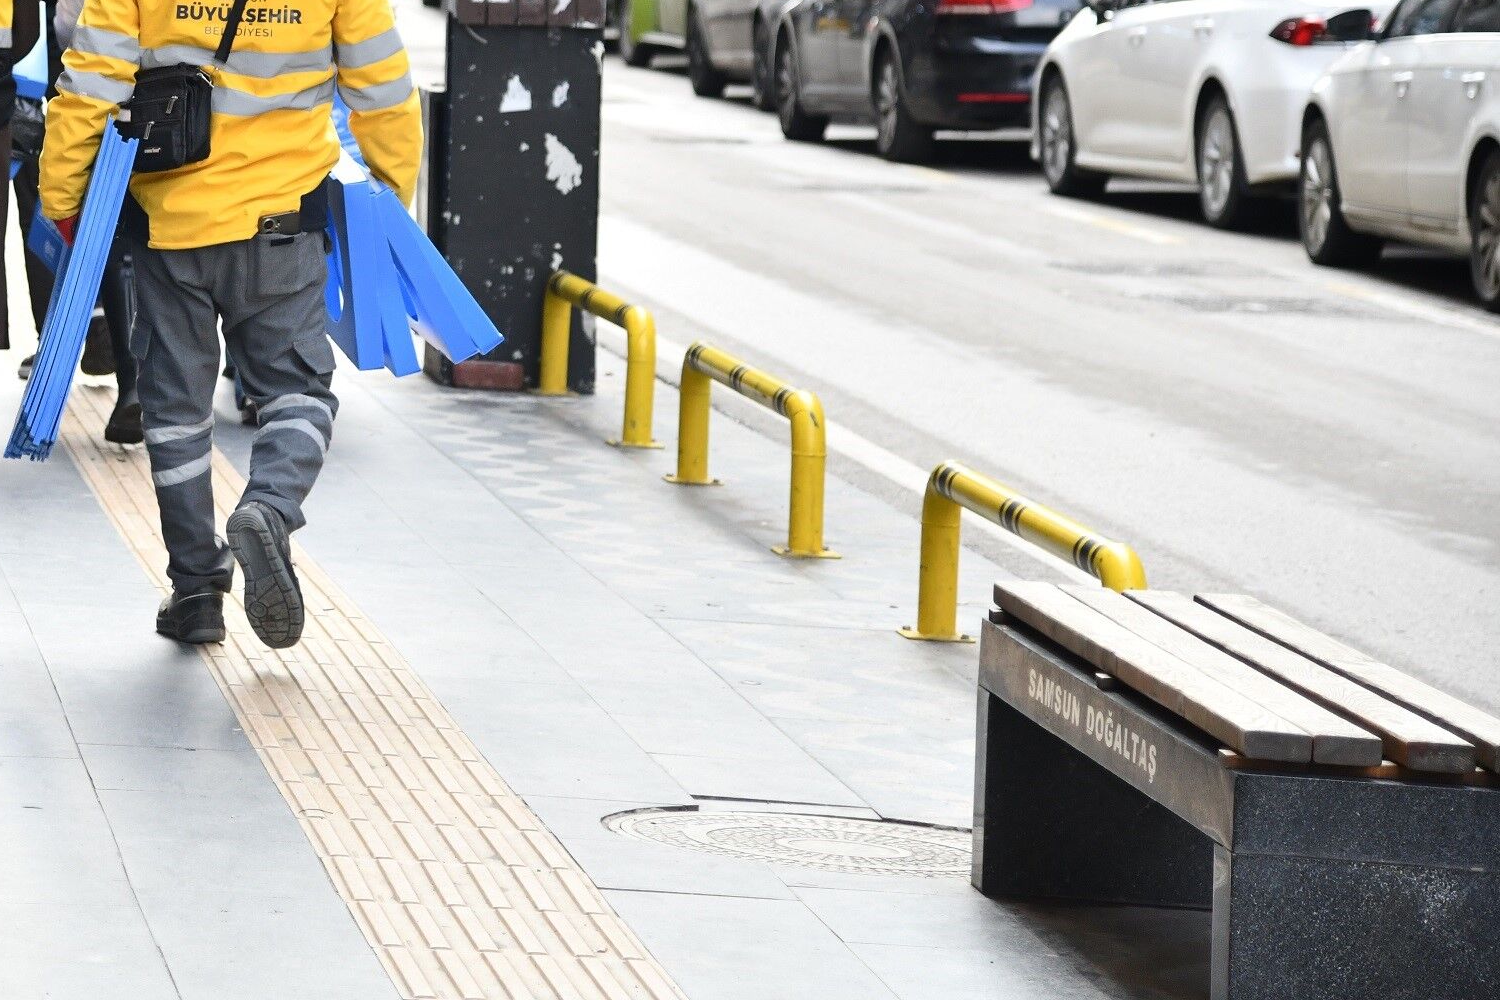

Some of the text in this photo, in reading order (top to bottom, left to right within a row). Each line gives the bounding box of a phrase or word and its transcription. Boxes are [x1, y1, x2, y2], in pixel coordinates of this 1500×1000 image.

[176, 2, 302, 25] BÜYÜŞEHİR
[1028, 668, 1157, 784] SAMSUN DOĞALTAŞ
